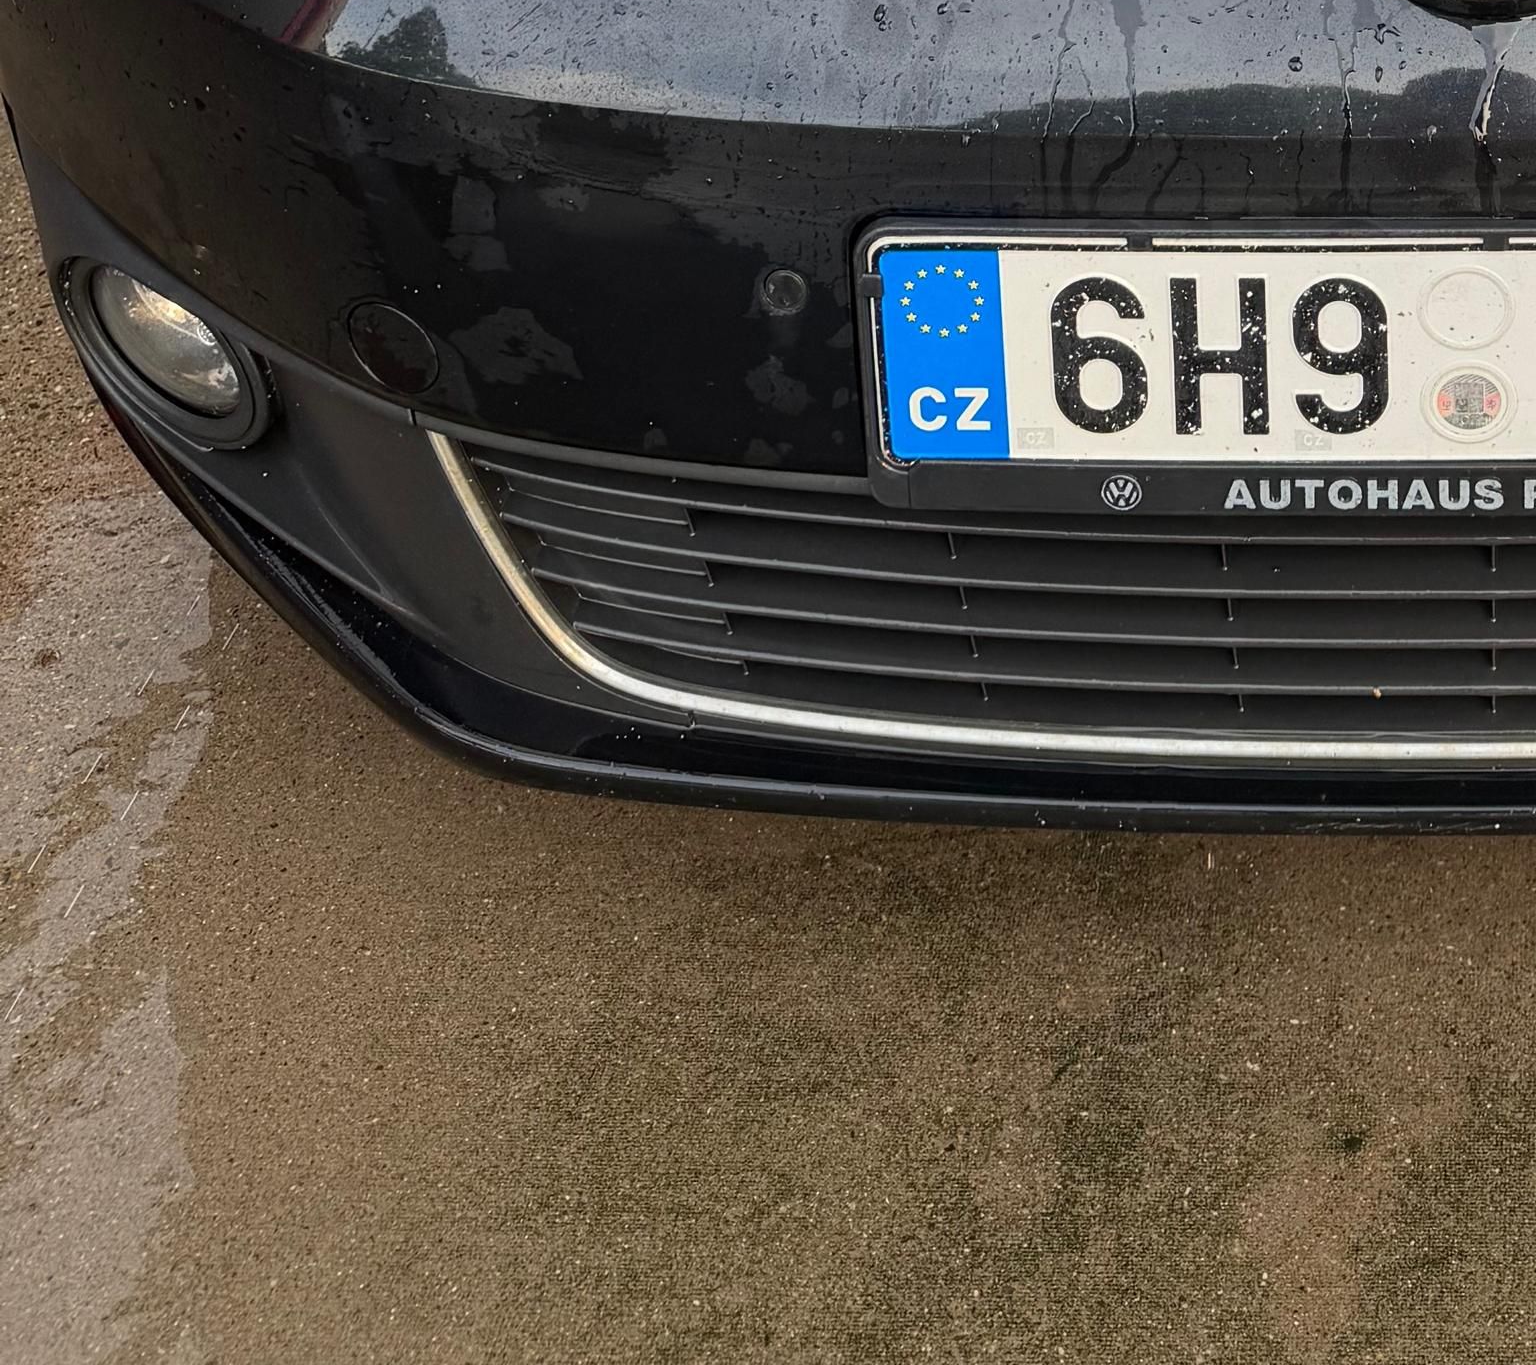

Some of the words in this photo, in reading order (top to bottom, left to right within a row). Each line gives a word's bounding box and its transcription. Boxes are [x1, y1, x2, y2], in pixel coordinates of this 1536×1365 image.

[1050, 276, 1389, 436] 6H9
[909, 386, 992, 432] CZ
[1224, 477, 1505, 511] AUTOHAUS
